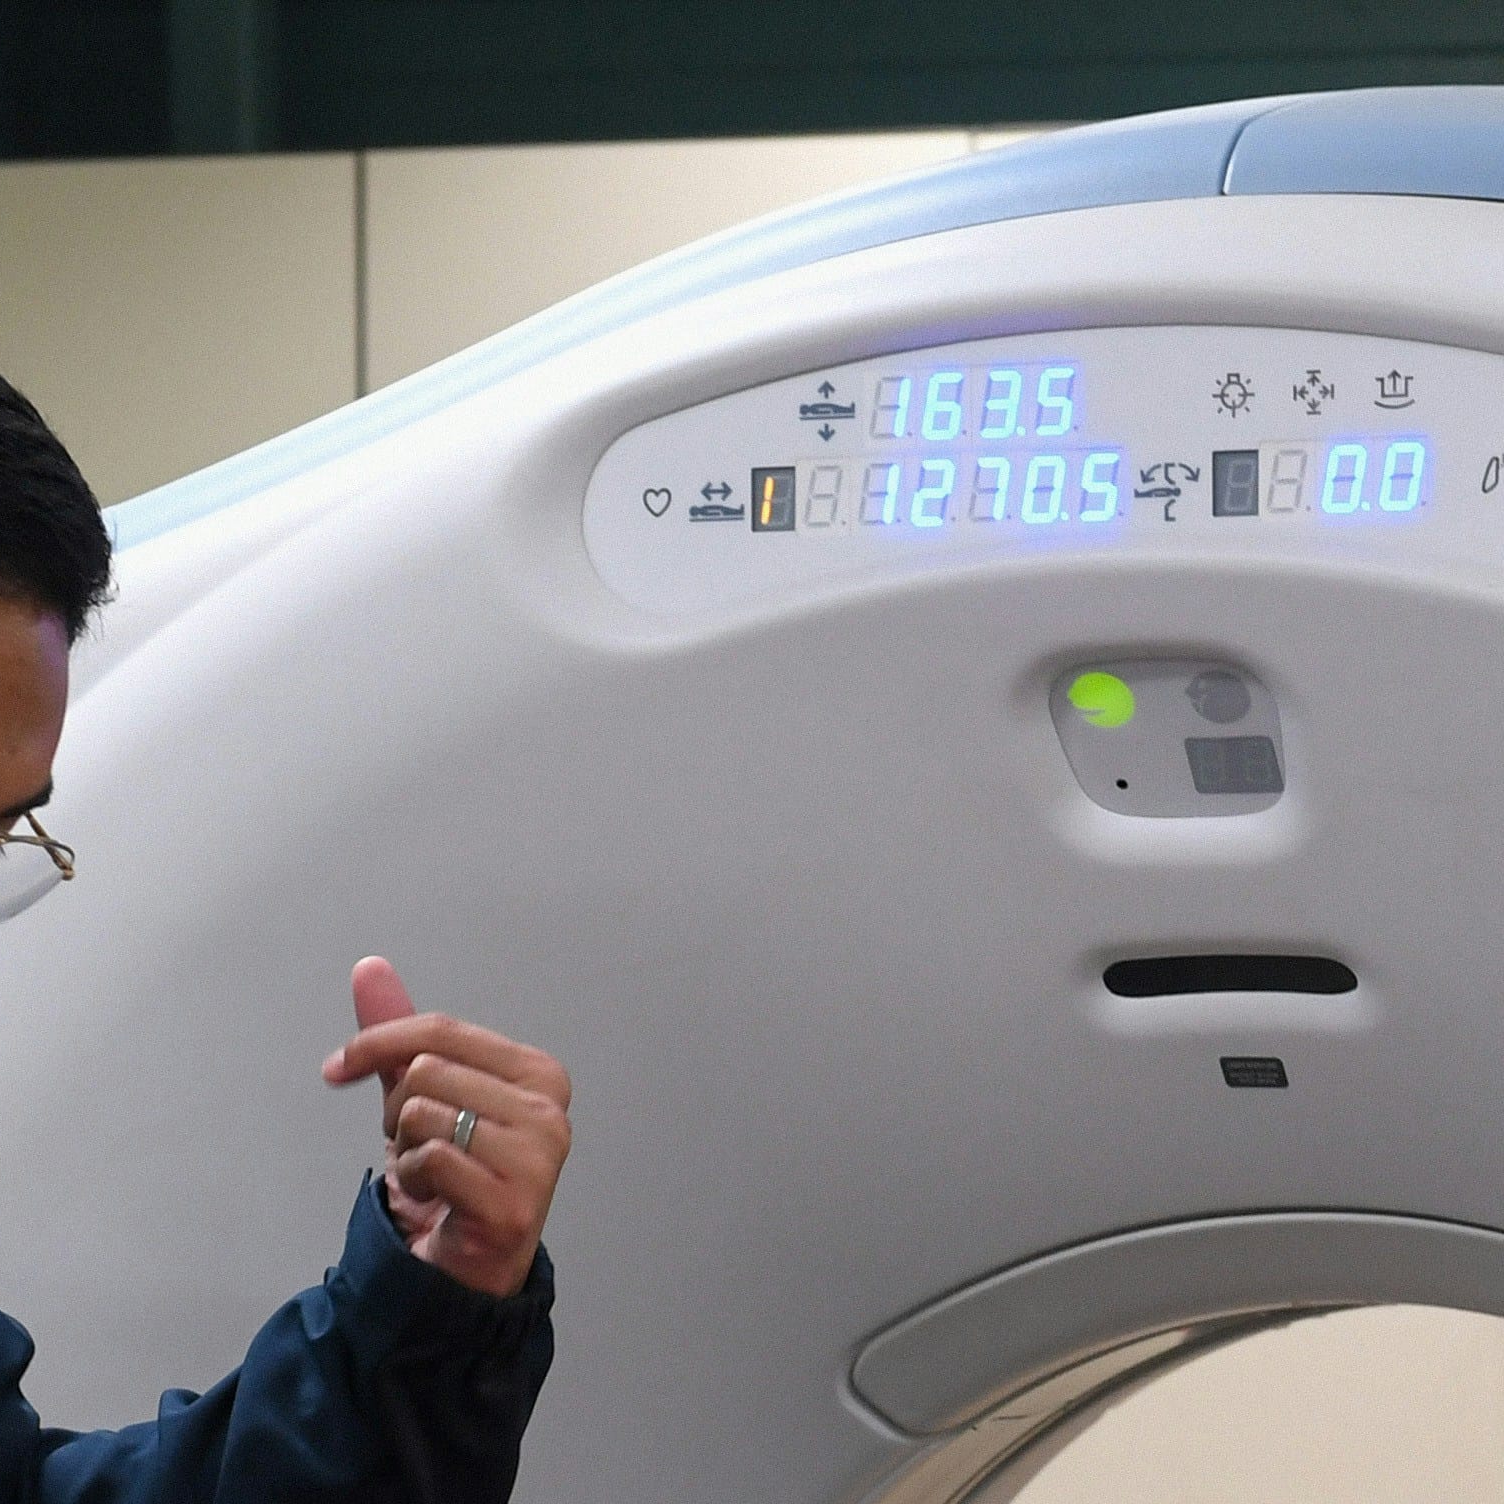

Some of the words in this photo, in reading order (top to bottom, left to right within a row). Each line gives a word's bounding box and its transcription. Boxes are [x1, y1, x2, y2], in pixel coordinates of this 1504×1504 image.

[892, 366, 1076, 441] 163.5
[880, 452, 1121, 528] 1270.5
[1320, 441, 1427, 515] 0.0
